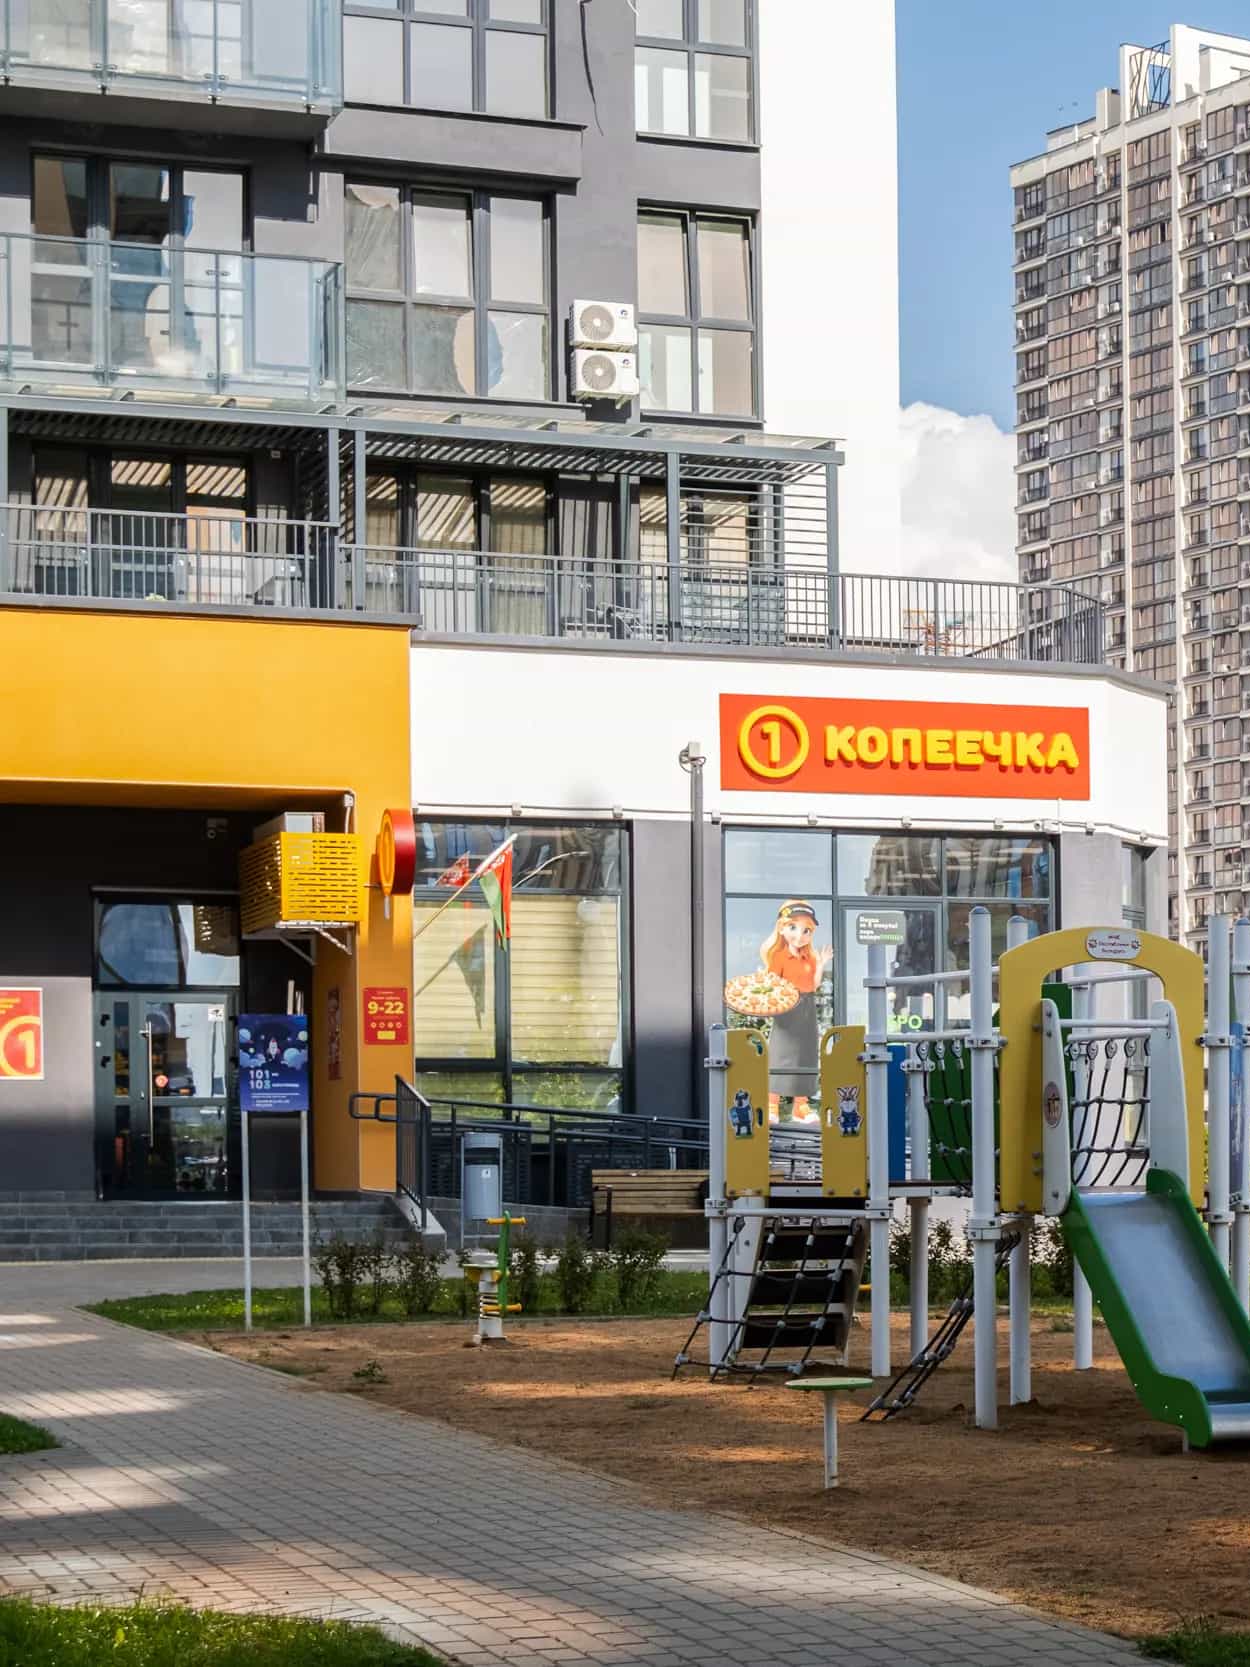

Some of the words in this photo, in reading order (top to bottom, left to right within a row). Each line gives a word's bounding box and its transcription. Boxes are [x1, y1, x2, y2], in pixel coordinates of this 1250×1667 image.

[761, 721, 781, 763] 1
[824, 724, 1080, 774] КОПЕЕЧКА
[368, 1001, 405, 1015] 9-22
[249, 1069, 270, 1080] 101
